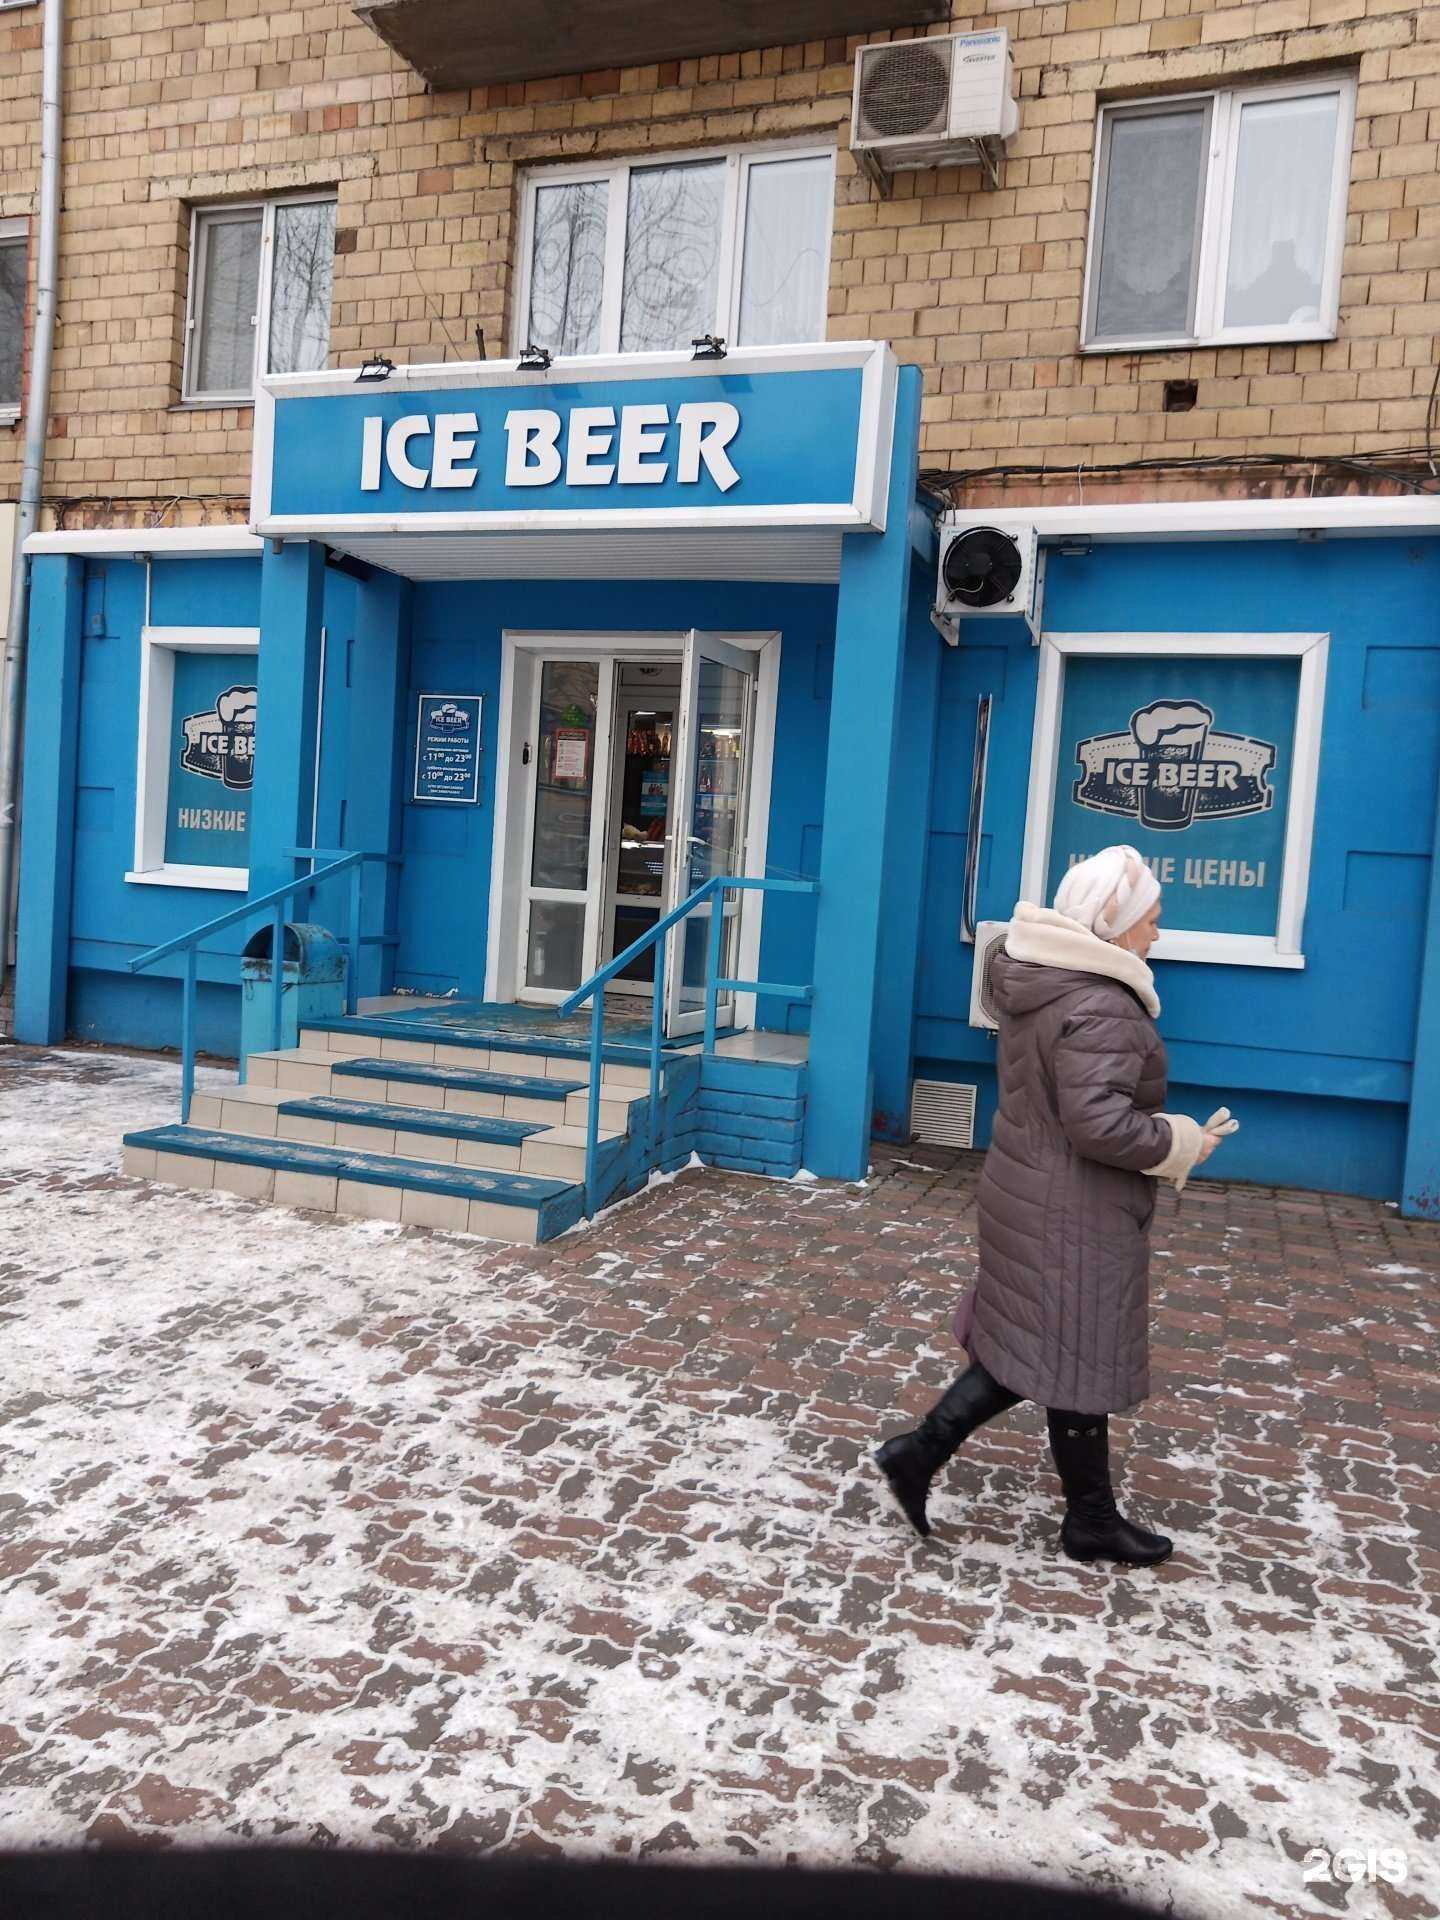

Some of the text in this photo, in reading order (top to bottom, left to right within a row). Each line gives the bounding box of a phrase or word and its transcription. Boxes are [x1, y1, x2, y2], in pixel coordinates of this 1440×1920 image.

[360, 402, 741, 493] ICE BEER
[201, 734, 256, 756] ICE BE
[445, 756, 454, 764] до
[443, 775, 453, 783] до
[1105, 761, 1240, 792] ICE BEER
[178, 807, 246, 832] НИЗКИЕ
[1183, 857, 1265, 889] ЦЕНЫ
